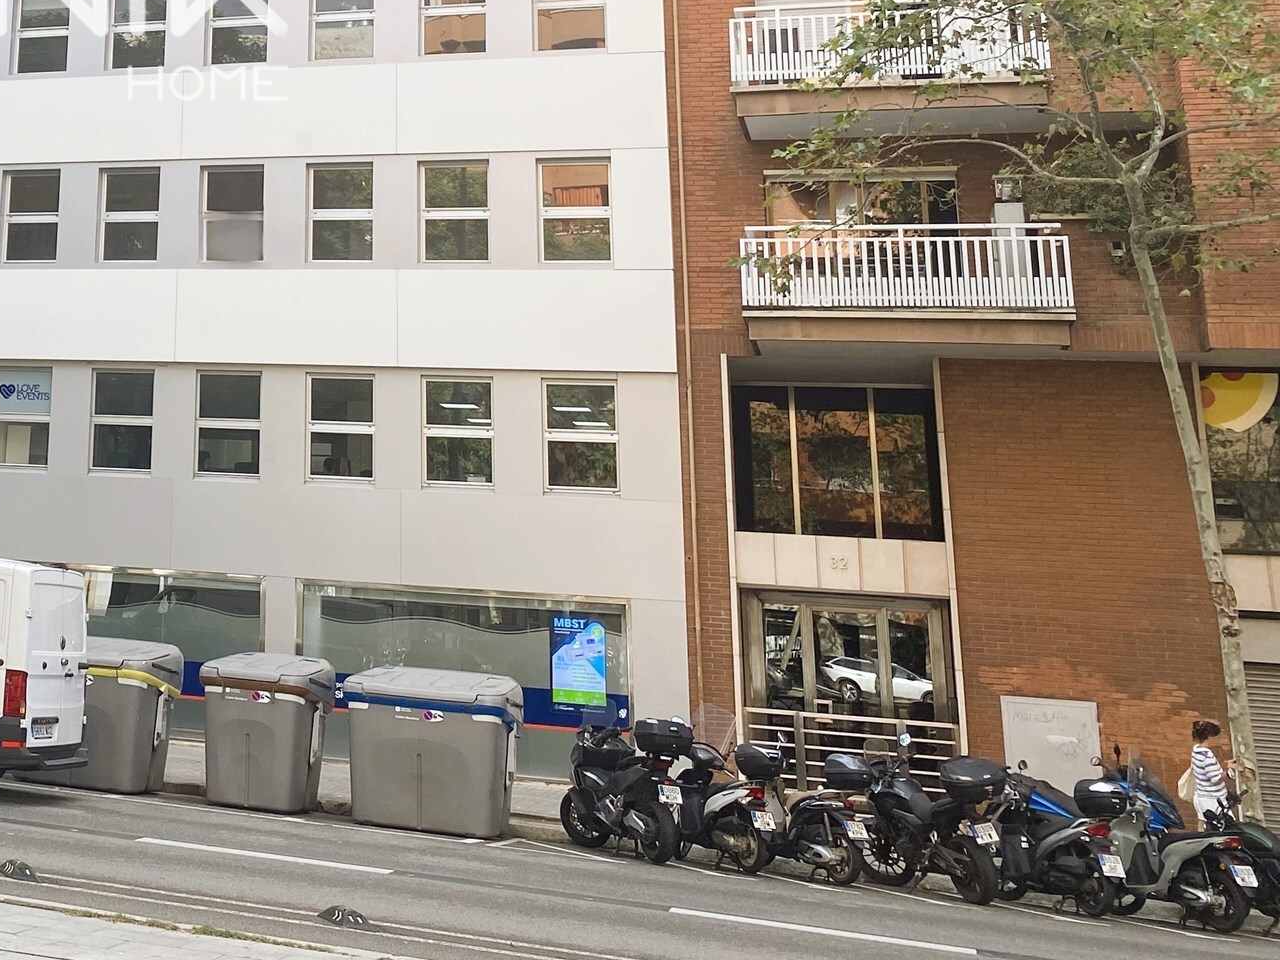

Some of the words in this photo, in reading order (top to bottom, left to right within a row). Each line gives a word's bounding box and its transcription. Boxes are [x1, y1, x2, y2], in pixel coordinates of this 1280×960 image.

[16, 383, 41, 393] LOVE
[16, 392, 50, 401] EVENTS
[830, 556, 848, 570] 32
[553, 617, 586, 629] MBST
